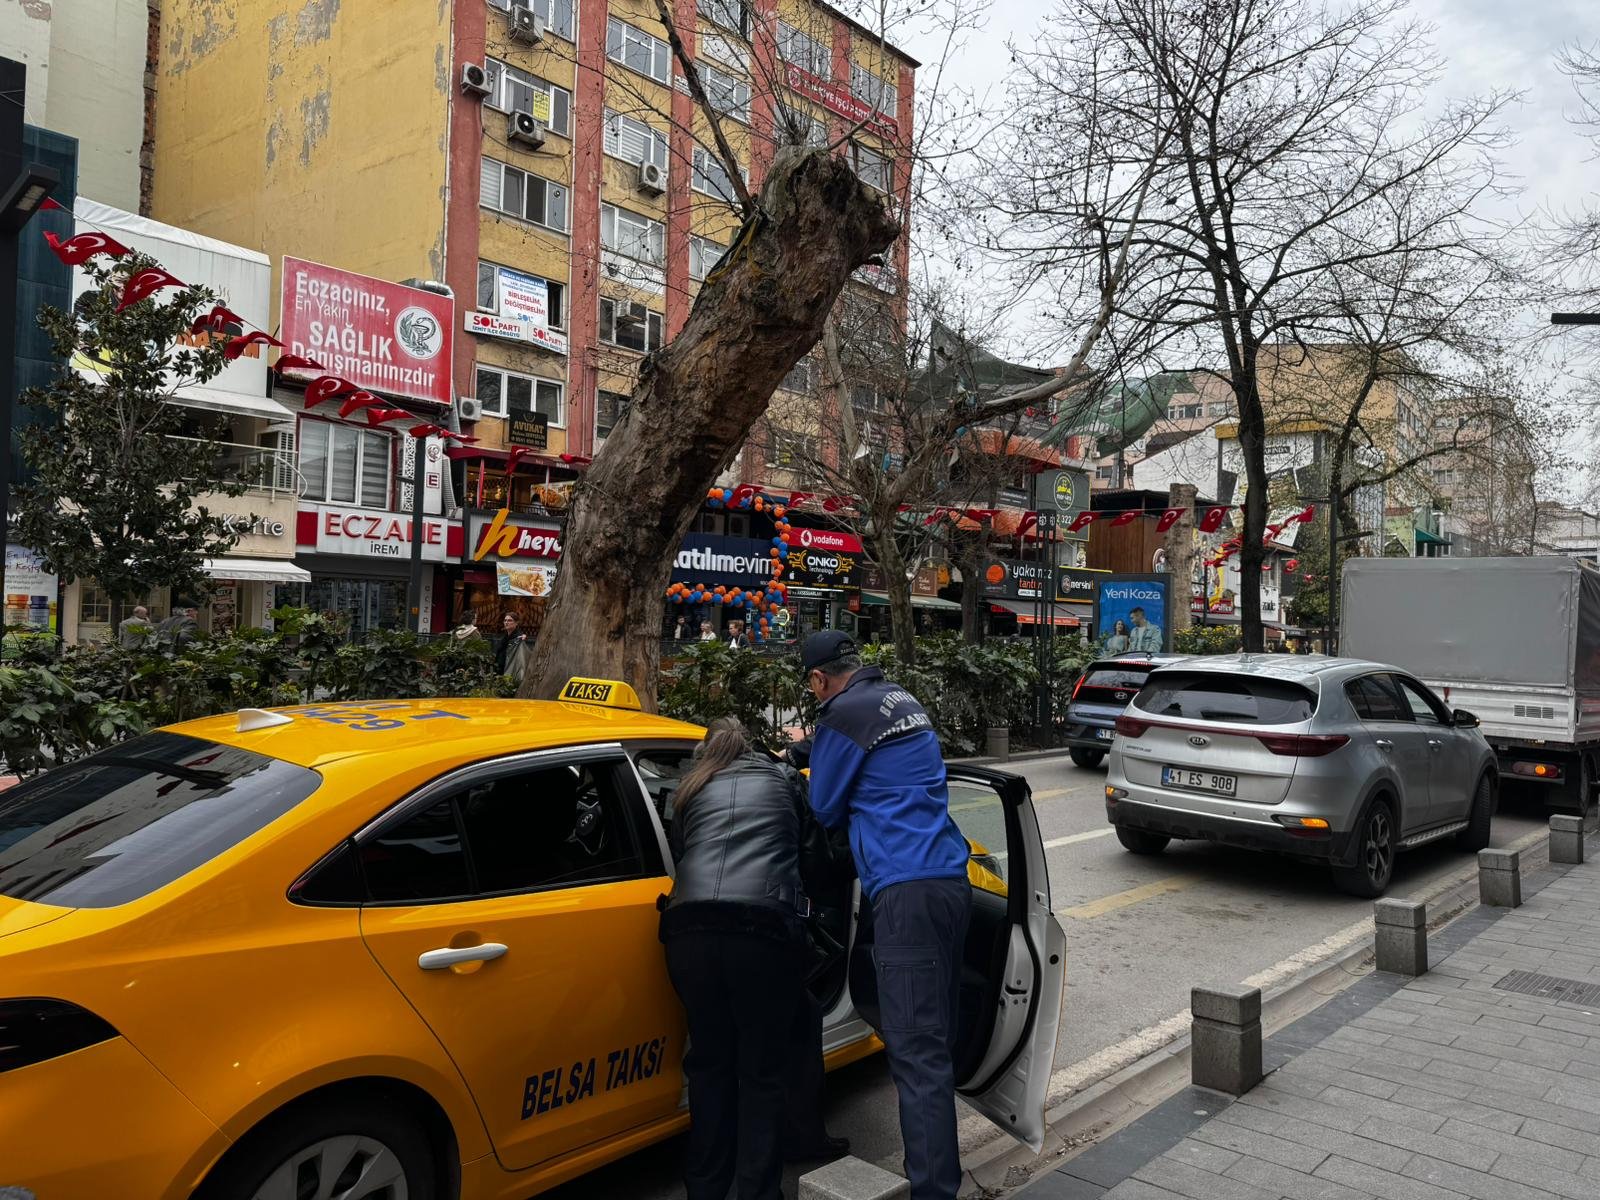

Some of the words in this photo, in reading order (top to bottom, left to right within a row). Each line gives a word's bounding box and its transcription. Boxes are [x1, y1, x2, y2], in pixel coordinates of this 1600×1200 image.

[296, 271, 390, 317] Eczacınız,
[295, 295, 312, 311] En
[317, 299, 349, 322] Yakın
[473, 315, 498, 329] SOL
[309, 321, 393, 361] SAĞLIK
[532, 327, 549, 342] SOL
[292, 341, 436, 388] Danışmanınızdır
[513, 421, 545, 434] AVUKAT
[428, 474, 438, 486] E
[370, 541, 399, 556] İREM
[813, 535, 843, 547] vodafone
[673, 546, 775, 575] atılımevim
[807, 555, 839, 568] ONKO
[1105, 588, 1128, 599] Yeni
[1129, 588, 1161, 600] Koza
[1191, 736, 1206, 745] KIA
[1169, 770, 1182, 783] 41
[1189, 773, 1202, 786] ES
[1211, 775, 1233, 791] 908
[521, 1057, 596, 1121] BELSA
